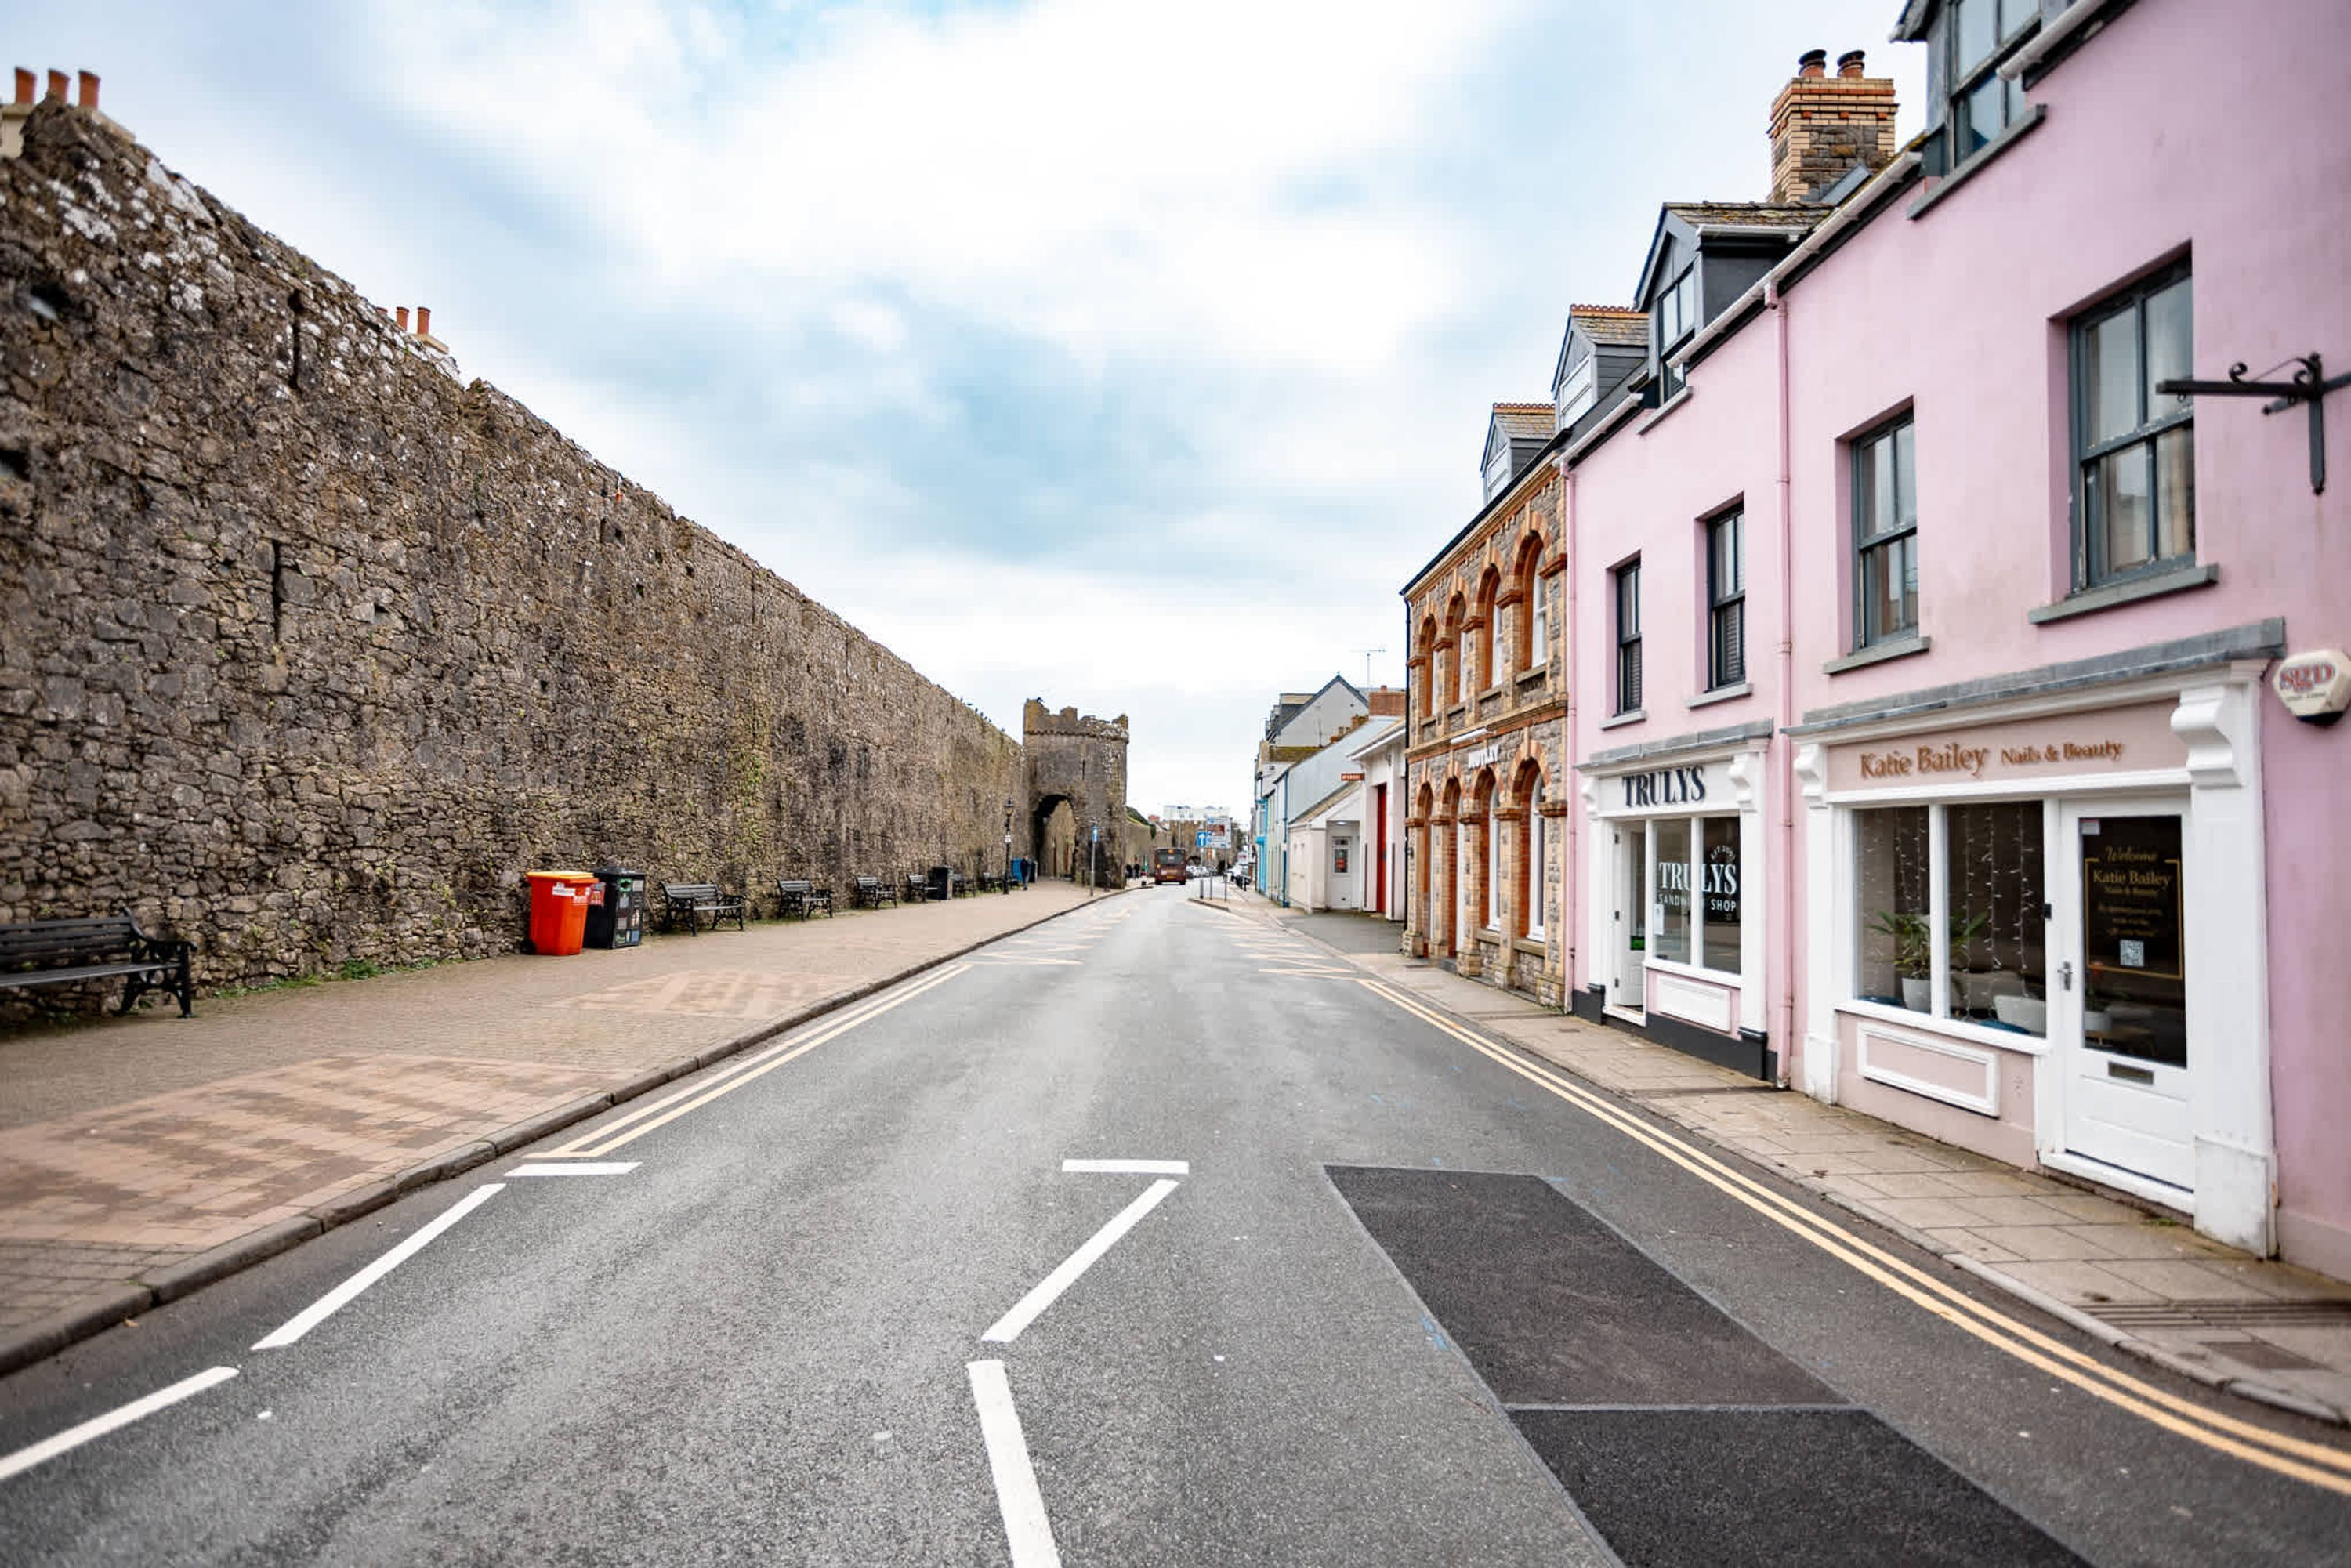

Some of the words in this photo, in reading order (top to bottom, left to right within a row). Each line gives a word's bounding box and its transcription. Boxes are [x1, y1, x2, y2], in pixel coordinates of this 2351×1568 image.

[1860, 751, 1912, 780] Katie
[1918, 743, 1988, 778] Bailey
[2001, 746, 2041, 766] Nails
[2045, 744, 2060, 762] &
[2063, 740, 2124, 762] Beauty
[1622, 764, 1706, 808] TRULYS
[2105, 845, 2157, 862] Welcome
[2093, 869, 2126, 883] Katie
[2129, 870, 2170, 886] Bailey
[1710, 898, 1737, 912] SHOP
